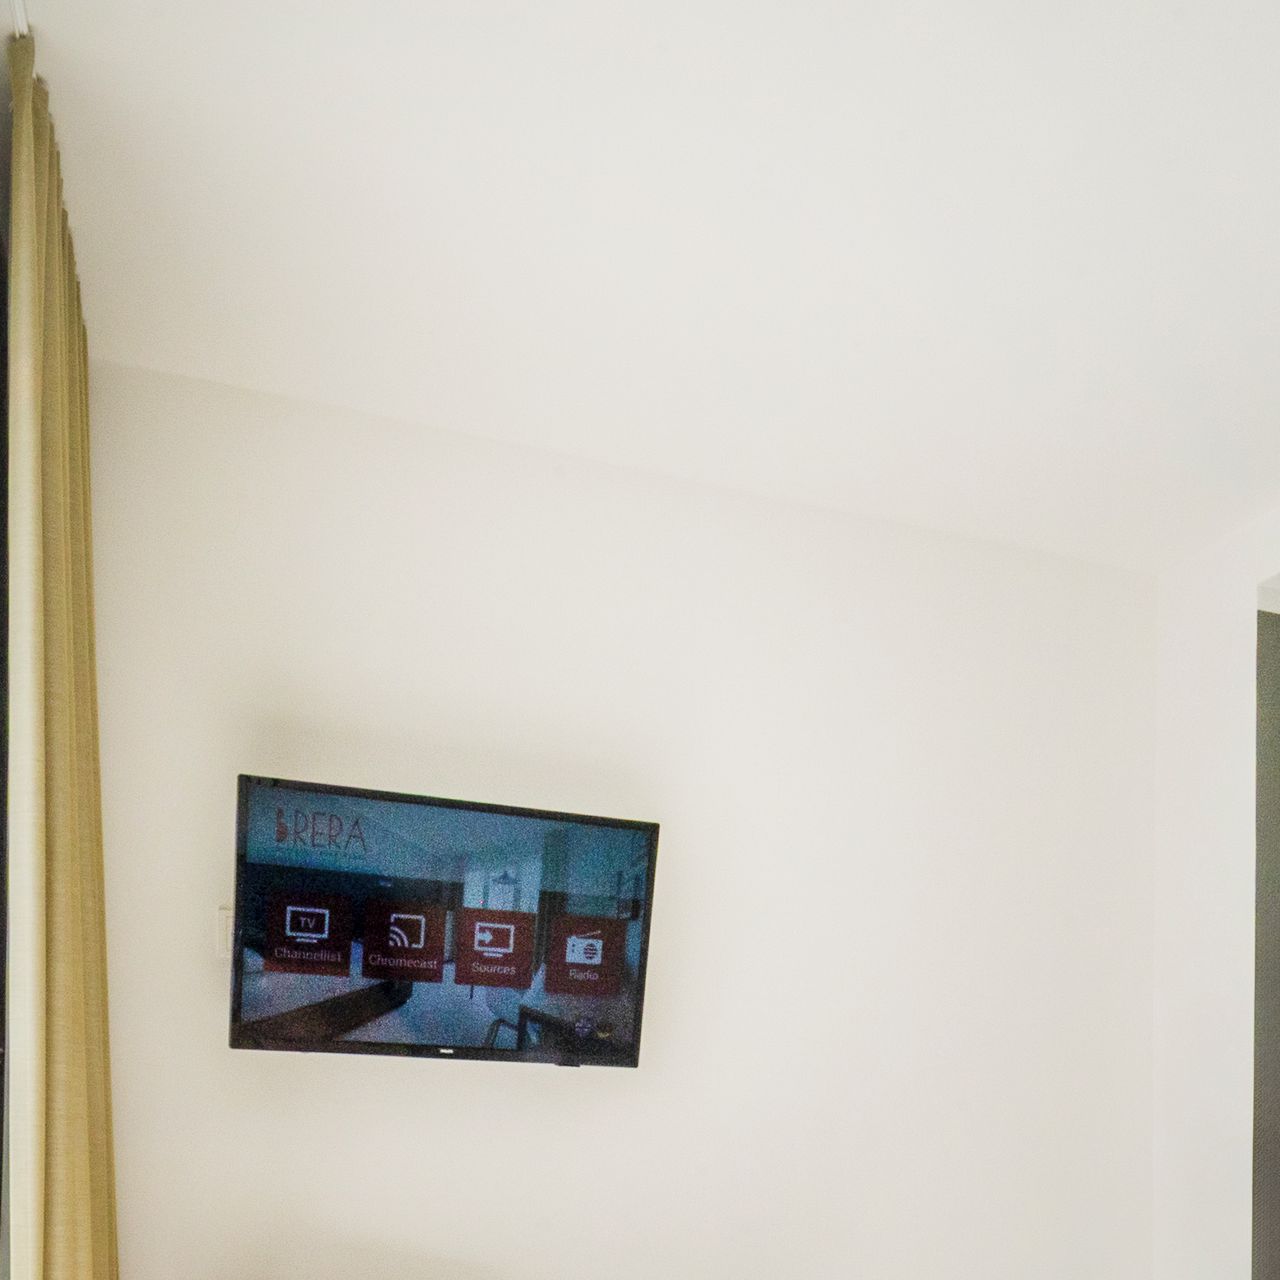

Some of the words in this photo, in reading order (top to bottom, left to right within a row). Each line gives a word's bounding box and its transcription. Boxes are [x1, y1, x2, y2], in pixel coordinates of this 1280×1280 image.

[275, 807, 367, 852] BRERA
[299, 917, 316, 929] TV
[369, 953, 438, 969] Chromecast
[472, 961, 517, 975] Sources
[570, 968, 599, 981] Radio
